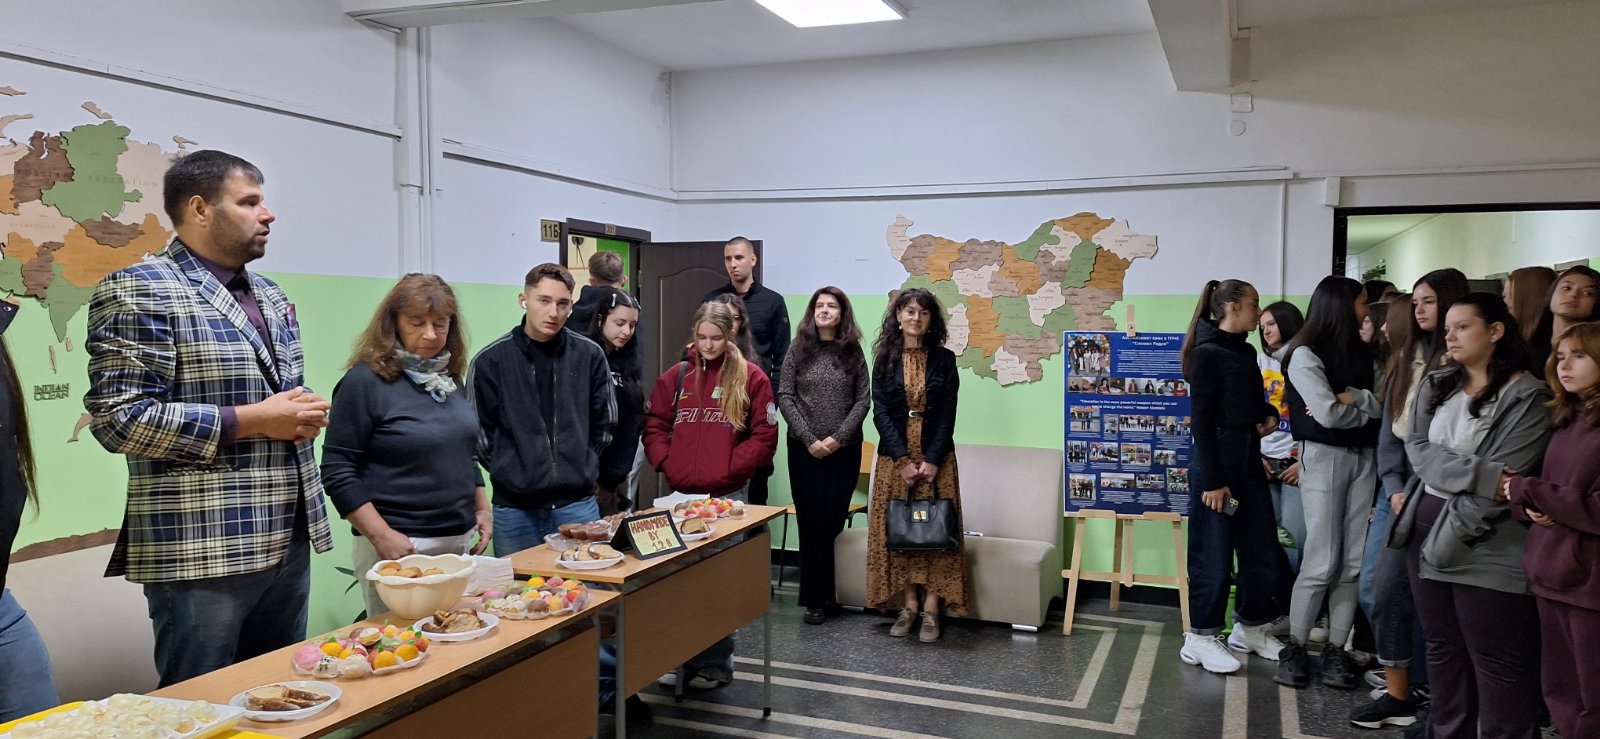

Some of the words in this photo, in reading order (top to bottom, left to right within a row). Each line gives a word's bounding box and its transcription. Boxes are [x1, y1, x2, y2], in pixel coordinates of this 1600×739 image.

[543, 223, 559, 238] 11Б
[34, 383, 70, 393] INDIAN
[34, 390, 69, 401] OCEAN
[630, 515, 670, 534] HANDMADE
[648, 530, 660, 541] BY
